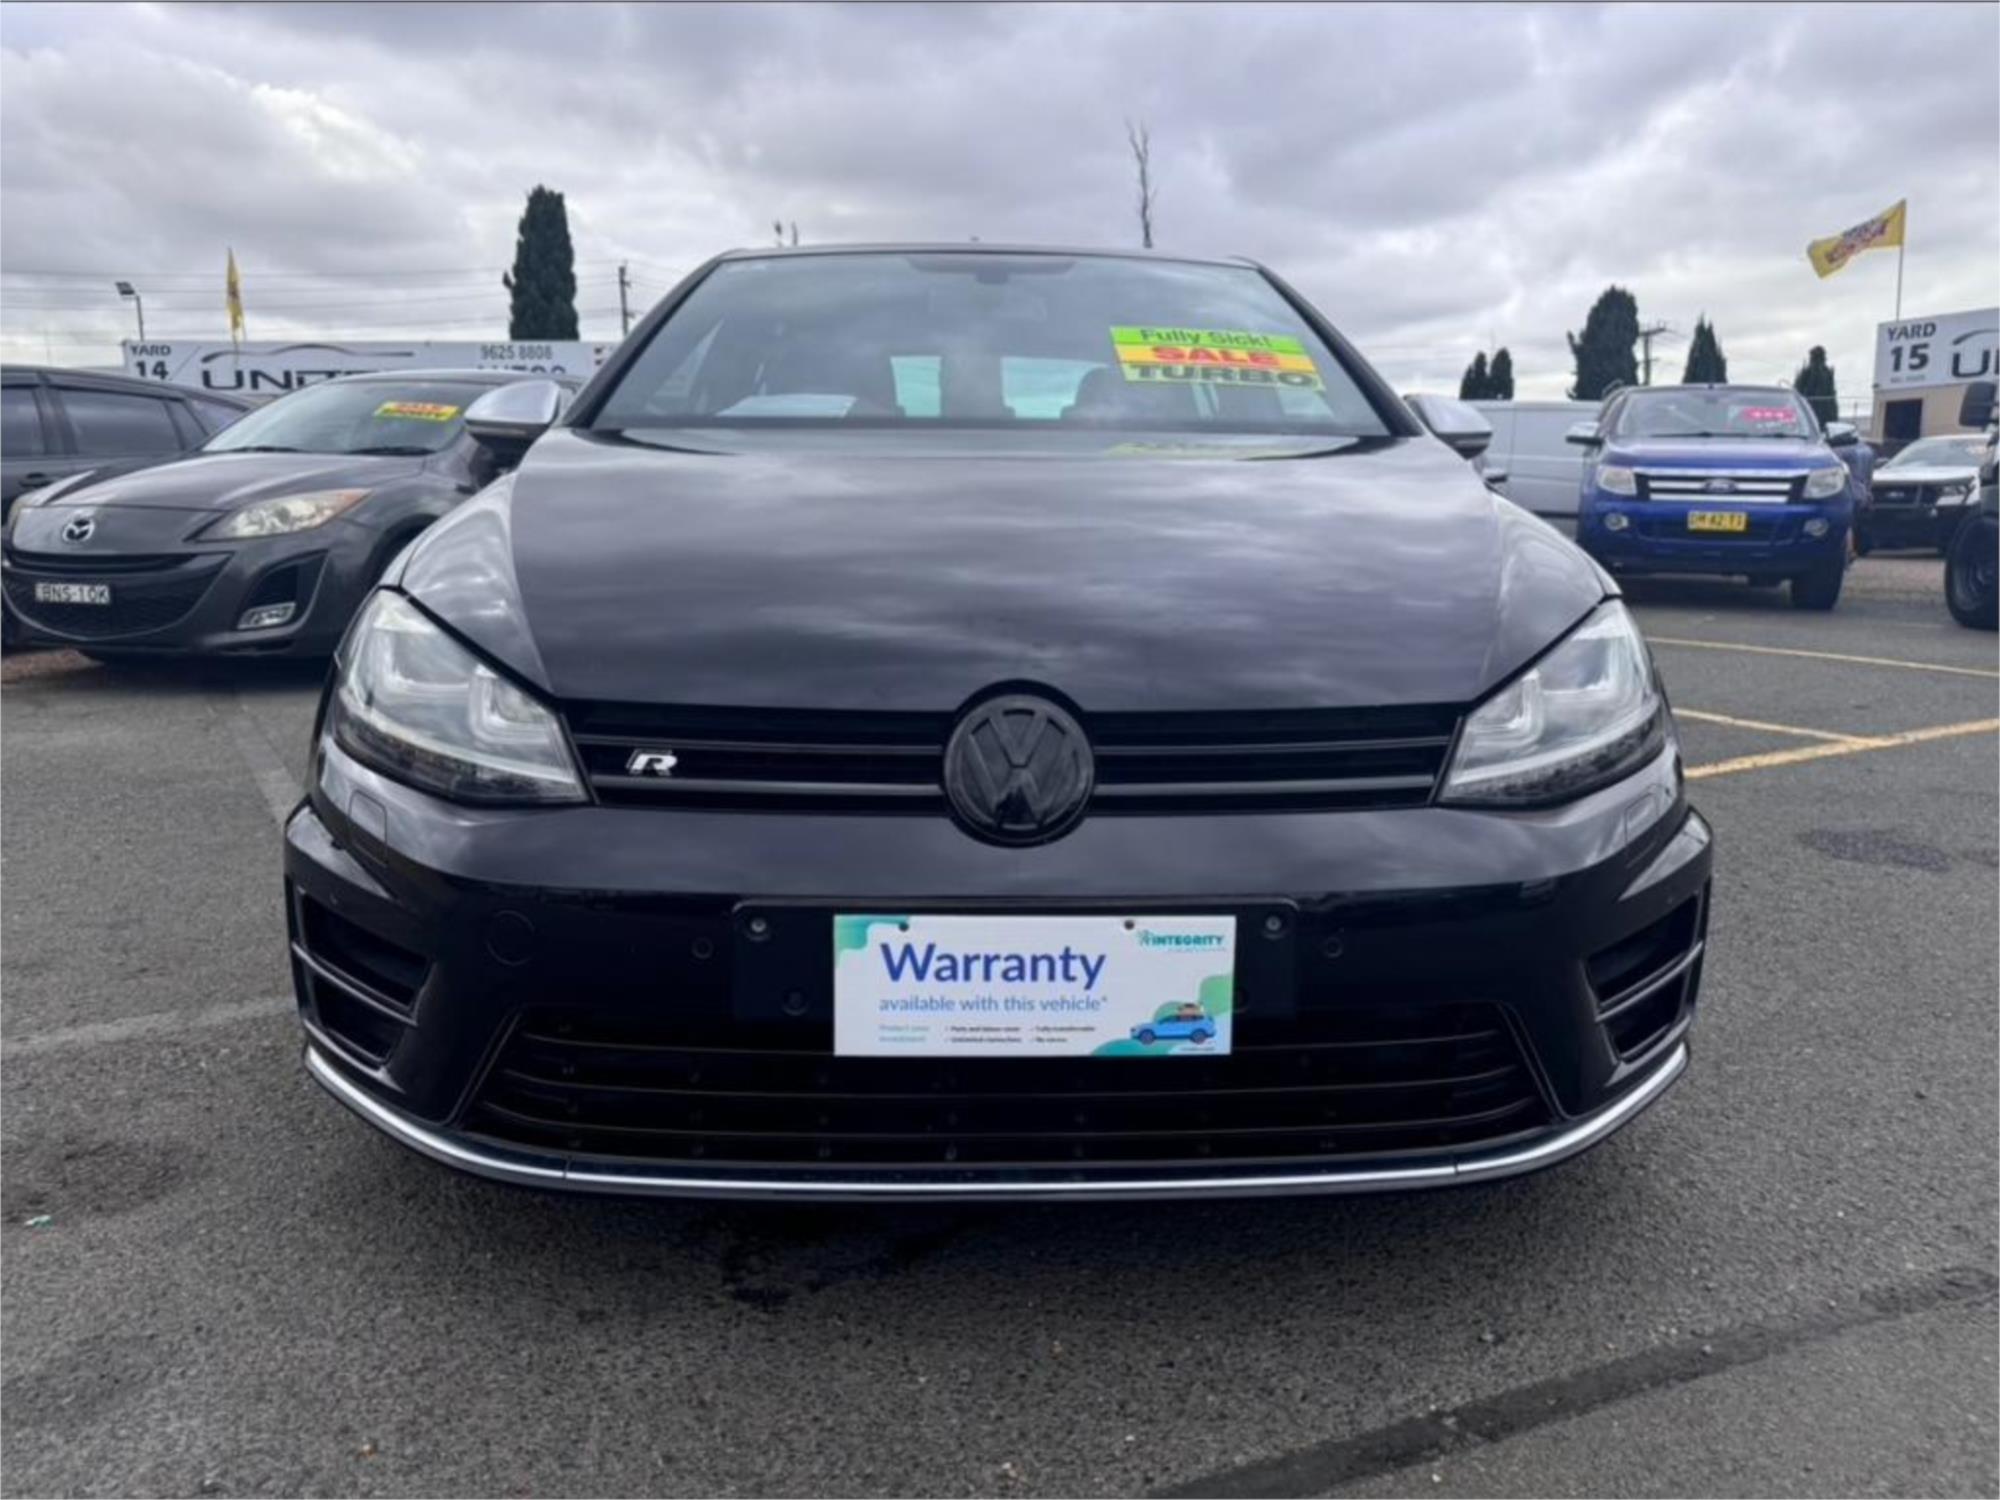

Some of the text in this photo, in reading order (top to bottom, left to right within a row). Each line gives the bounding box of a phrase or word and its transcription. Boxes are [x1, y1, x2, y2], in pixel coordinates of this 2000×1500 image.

[1141, 329, 1272, 347] Fully Sick!
[1887, 322, 1937, 341] YARD
[130, 344, 171, 356] YARD
[480, 344, 515, 360] 9625
[1151, 346, 1280, 366] SALE
[1890, 343, 1930, 372] 15
[136, 361, 169, 380] 14
[1951, 348, 1999, 378] U
[1130, 364, 1313, 386] TURBO
[625, 749, 678, 775] R
[1151, 934, 1224, 946] INTEGRITY
[880, 942, 1106, 990] Warranty
[878, 995, 956, 1012] available
[959, 995, 999, 1012] with
[1003, 995, 1036, 1012] this
